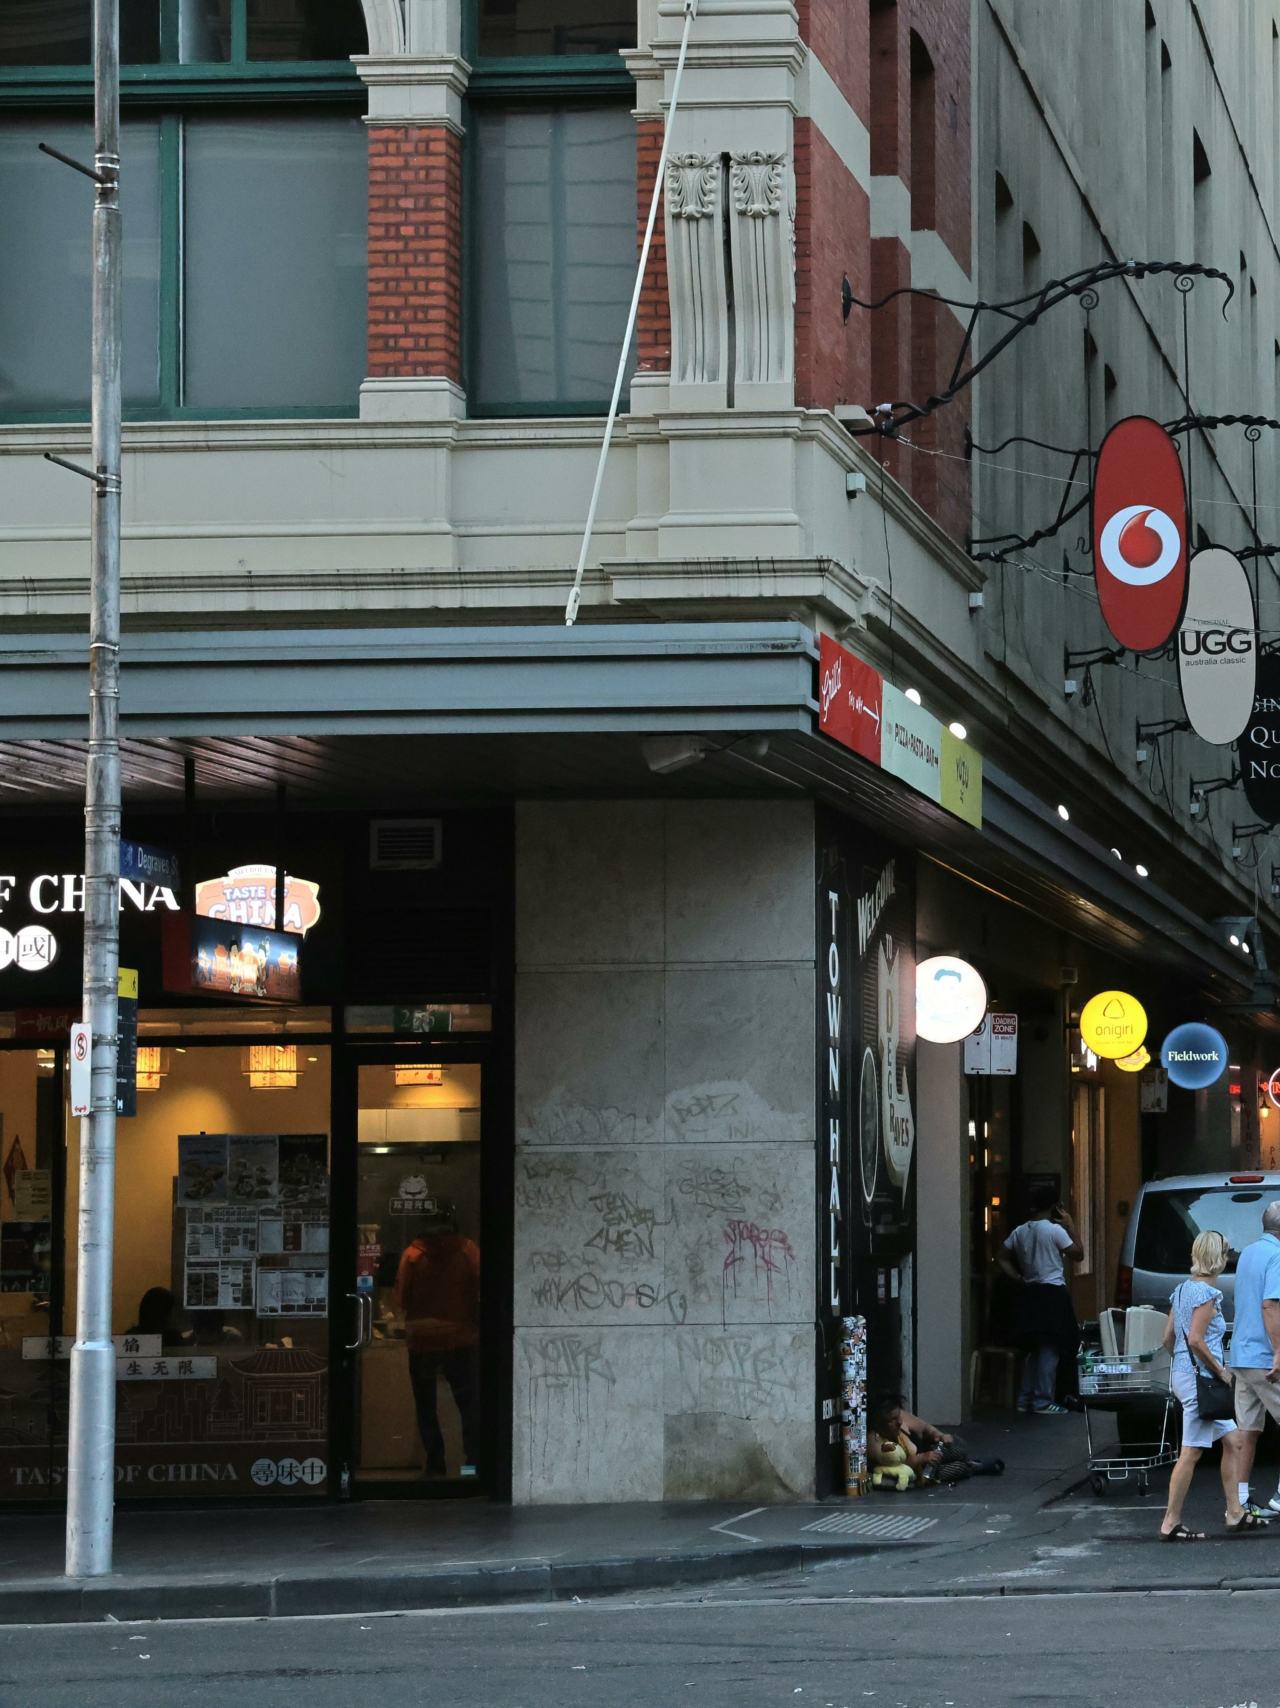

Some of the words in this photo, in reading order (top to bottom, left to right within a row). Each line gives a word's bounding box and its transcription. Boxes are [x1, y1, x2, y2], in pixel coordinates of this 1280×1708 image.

[1180, 629, 1252, 656] UGG
[1185, 658, 1218, 667] australia
[1219, 656, 1246, 665] classic
[894, 722, 909, 750] PIZZA
[910, 732, 924, 761] PASTA
[956, 756, 970, 790] YUZU
[137, 846, 170, 875] Degraves
[30, 875, 180, 914] CHNA
[223, 886, 266, 901] TASTE
[857, 858, 896, 956] WELCOME
[885, 933, 893, 960] TO
[992, 1017, 1016, 1025] LOADING
[994, 1025, 1015, 1033] ZONE
[1095, 1024, 1134, 1039] onigiri
[886, 988, 909, 1149] DEGRAVES
[1168, 1051, 1219, 1062] Fieldwork
[125, 1360, 196, 1377] 生无限
[10, 1466, 68, 1485] TAS
[147, 1462, 239, 1482] CHINA
